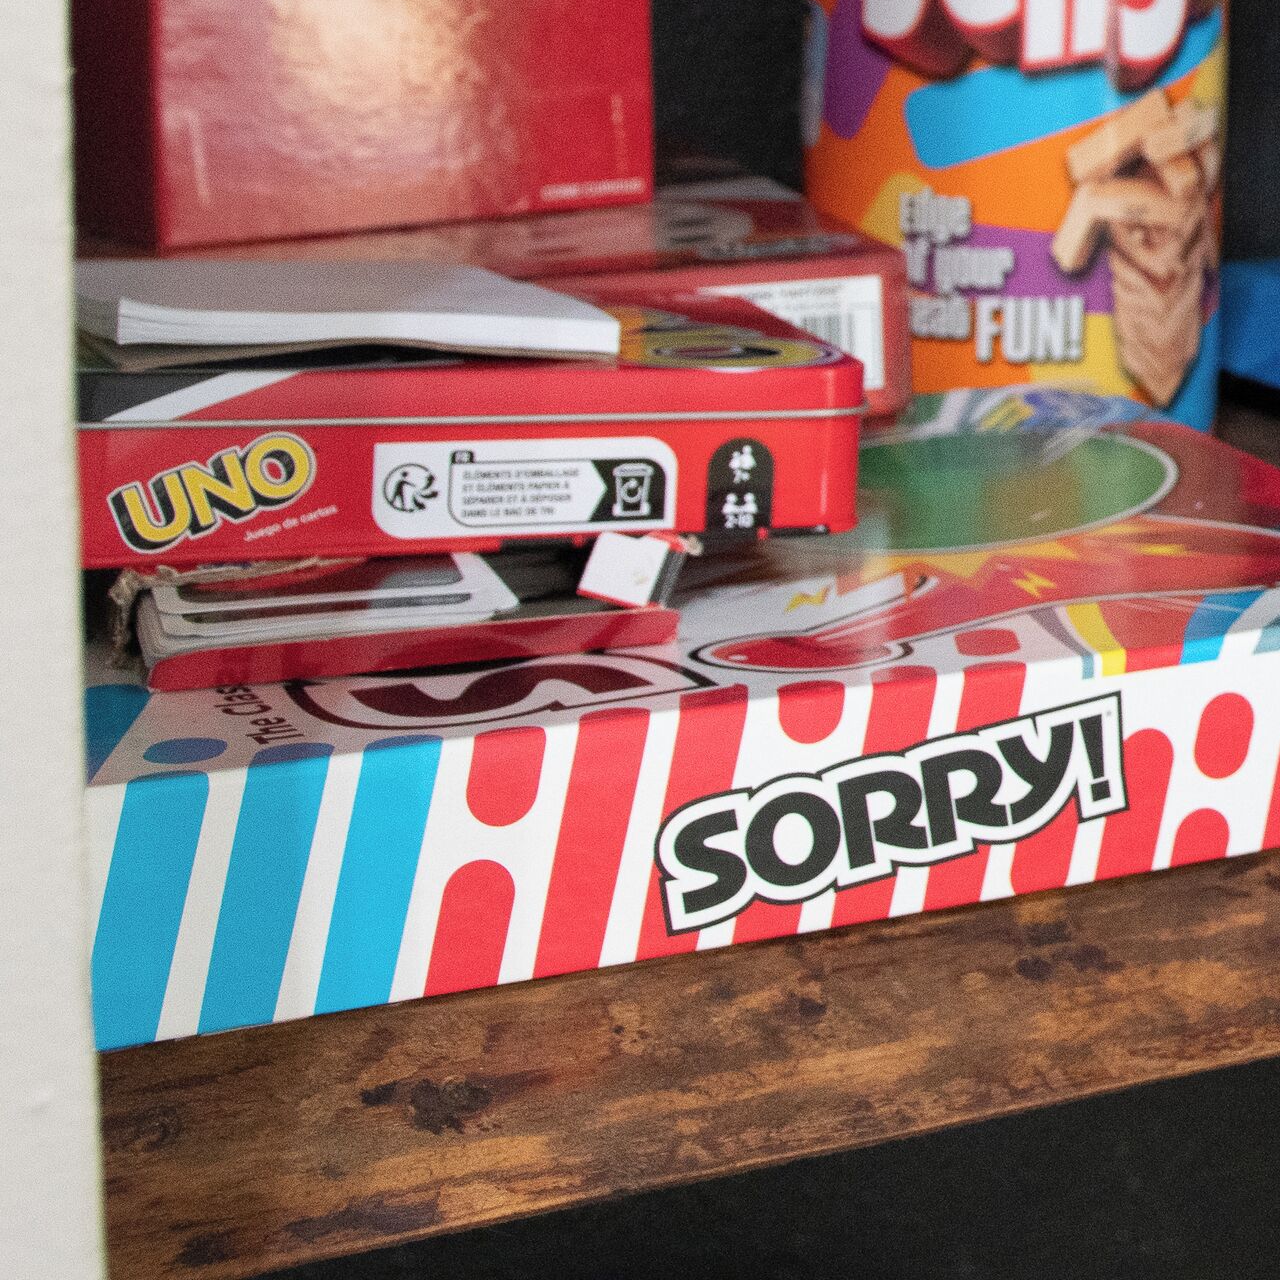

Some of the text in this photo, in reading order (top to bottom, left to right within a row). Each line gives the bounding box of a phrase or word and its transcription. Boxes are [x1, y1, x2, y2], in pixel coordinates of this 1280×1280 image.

[975, 295, 1084, 364] FUN!
[109, 433, 315, 553] UNO
[282, 518, 299, 529] de
[214, 684, 272, 716] Clas
[245, 716, 305, 745] The
[673, 713, 1111, 915] SORRY!
